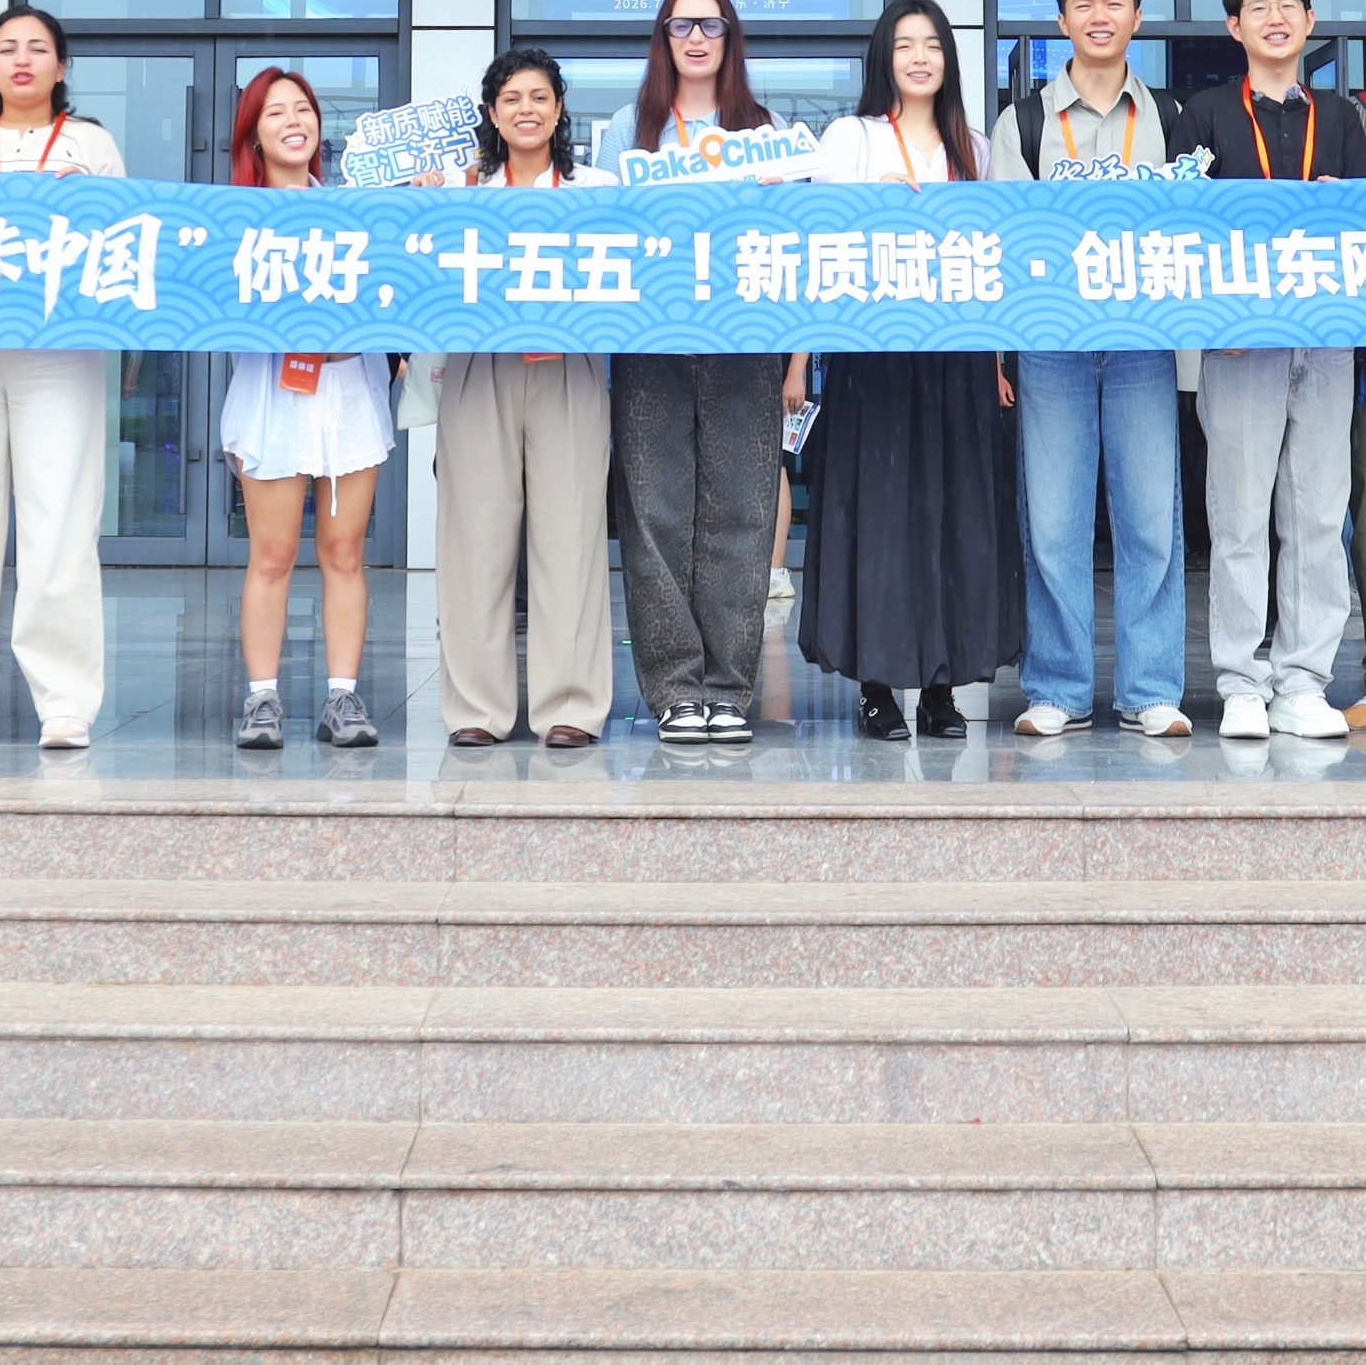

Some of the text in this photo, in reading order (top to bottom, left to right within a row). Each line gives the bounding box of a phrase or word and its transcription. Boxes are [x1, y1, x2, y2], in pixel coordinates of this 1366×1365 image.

[362, 96, 477, 147] 新质赋能
[346, 131, 475, 186] 智汇济宁
